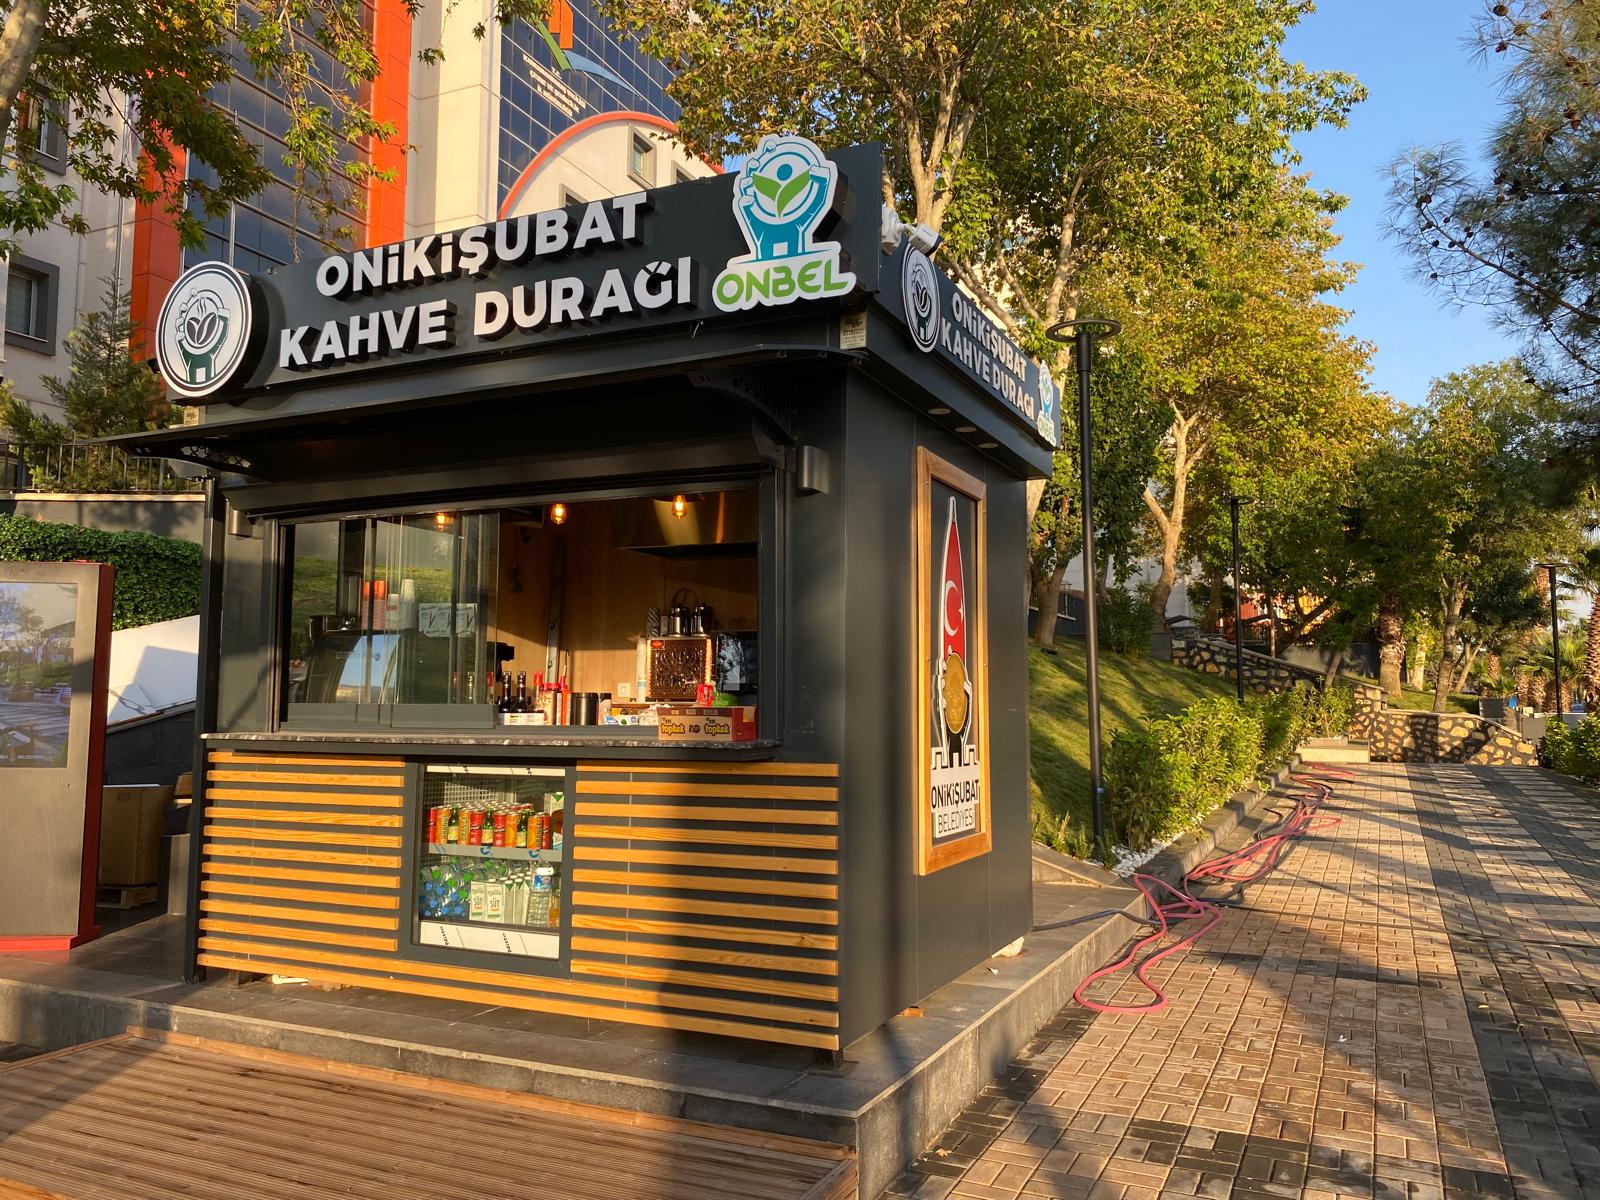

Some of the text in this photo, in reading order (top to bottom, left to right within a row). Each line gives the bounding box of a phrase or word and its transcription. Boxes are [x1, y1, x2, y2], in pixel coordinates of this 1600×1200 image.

[715, 258, 849, 306] ONBEL
[279, 299, 449, 369] KAHVE
[941, 317, 990, 384] KAHVE
